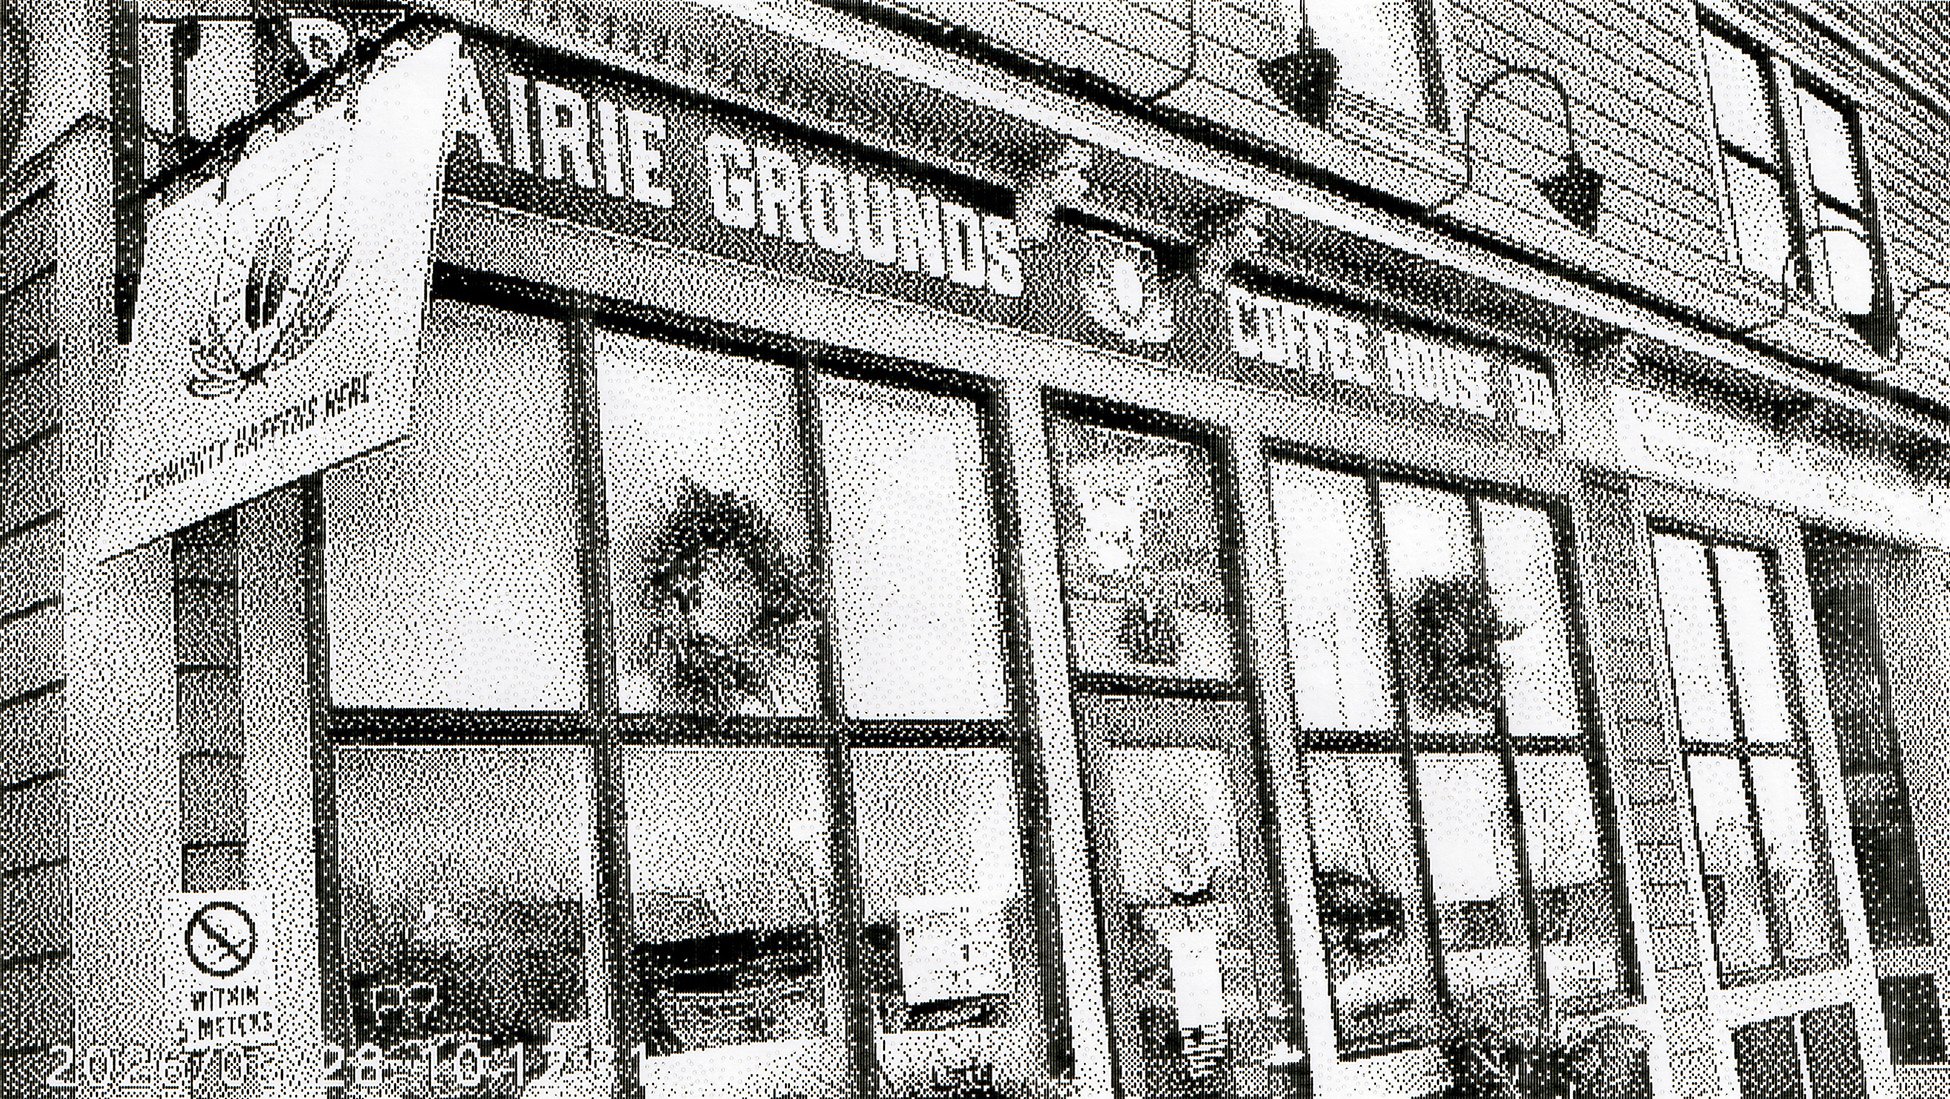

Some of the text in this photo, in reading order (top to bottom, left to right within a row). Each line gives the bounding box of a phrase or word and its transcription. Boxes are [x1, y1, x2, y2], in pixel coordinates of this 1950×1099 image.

[288, 17, 1023, 298] PAIRIE GROUNDS
[1227, 285, 1375, 386] COFFEE
[1381, 331, 1496, 419] HOUSE
[190, 984, 259, 1012] WITHIN
